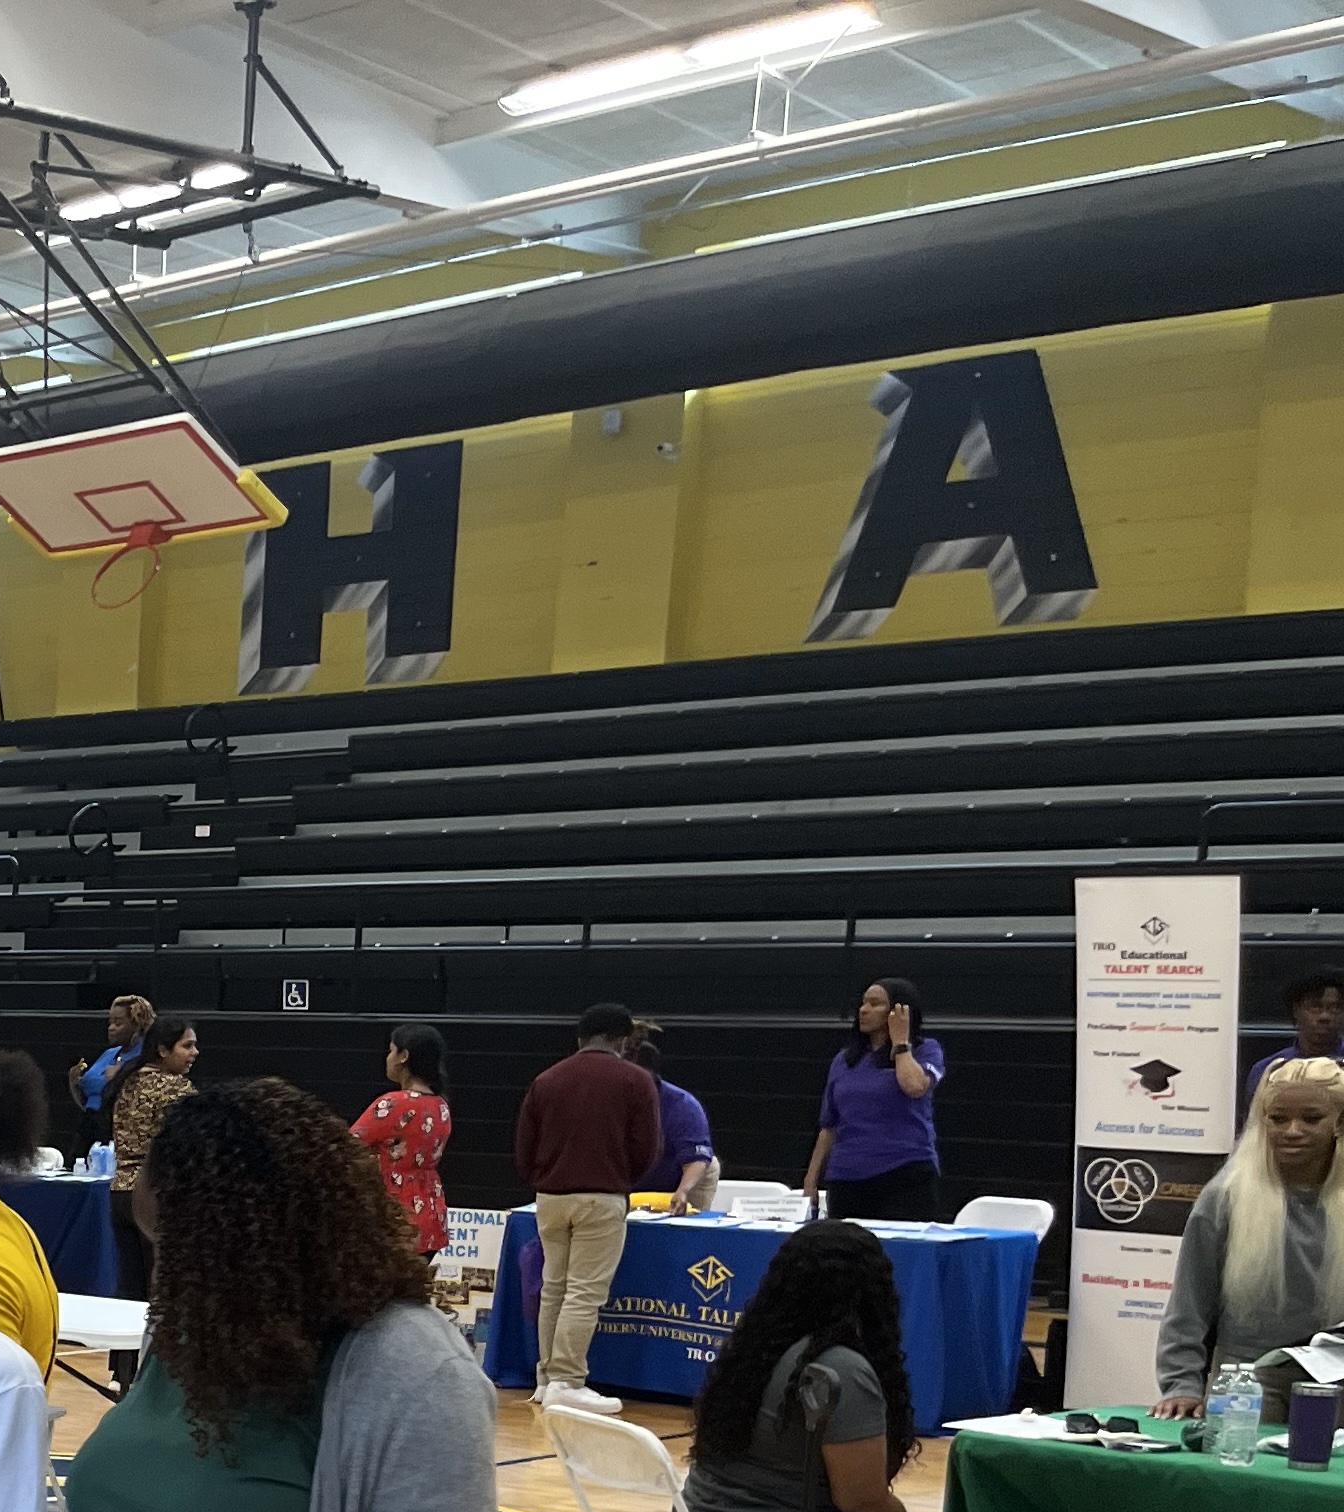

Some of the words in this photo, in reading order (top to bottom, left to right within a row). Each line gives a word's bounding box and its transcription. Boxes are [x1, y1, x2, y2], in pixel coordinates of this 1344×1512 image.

[1120, 950, 1188, 960] Educational
[1104, 964, 1150, 975] TALENT
[1156, 965, 1204, 975] SEARCH
[1094, 1121, 1135, 1134] Access
[1138, 1122, 1155, 1135] for
[1157, 1124, 1205, 1137] Success
[448, 1210, 505, 1226] TIONAL
[448, 1227, 479, 1241] ENT
[597, 1321, 638, 1334] THERN
